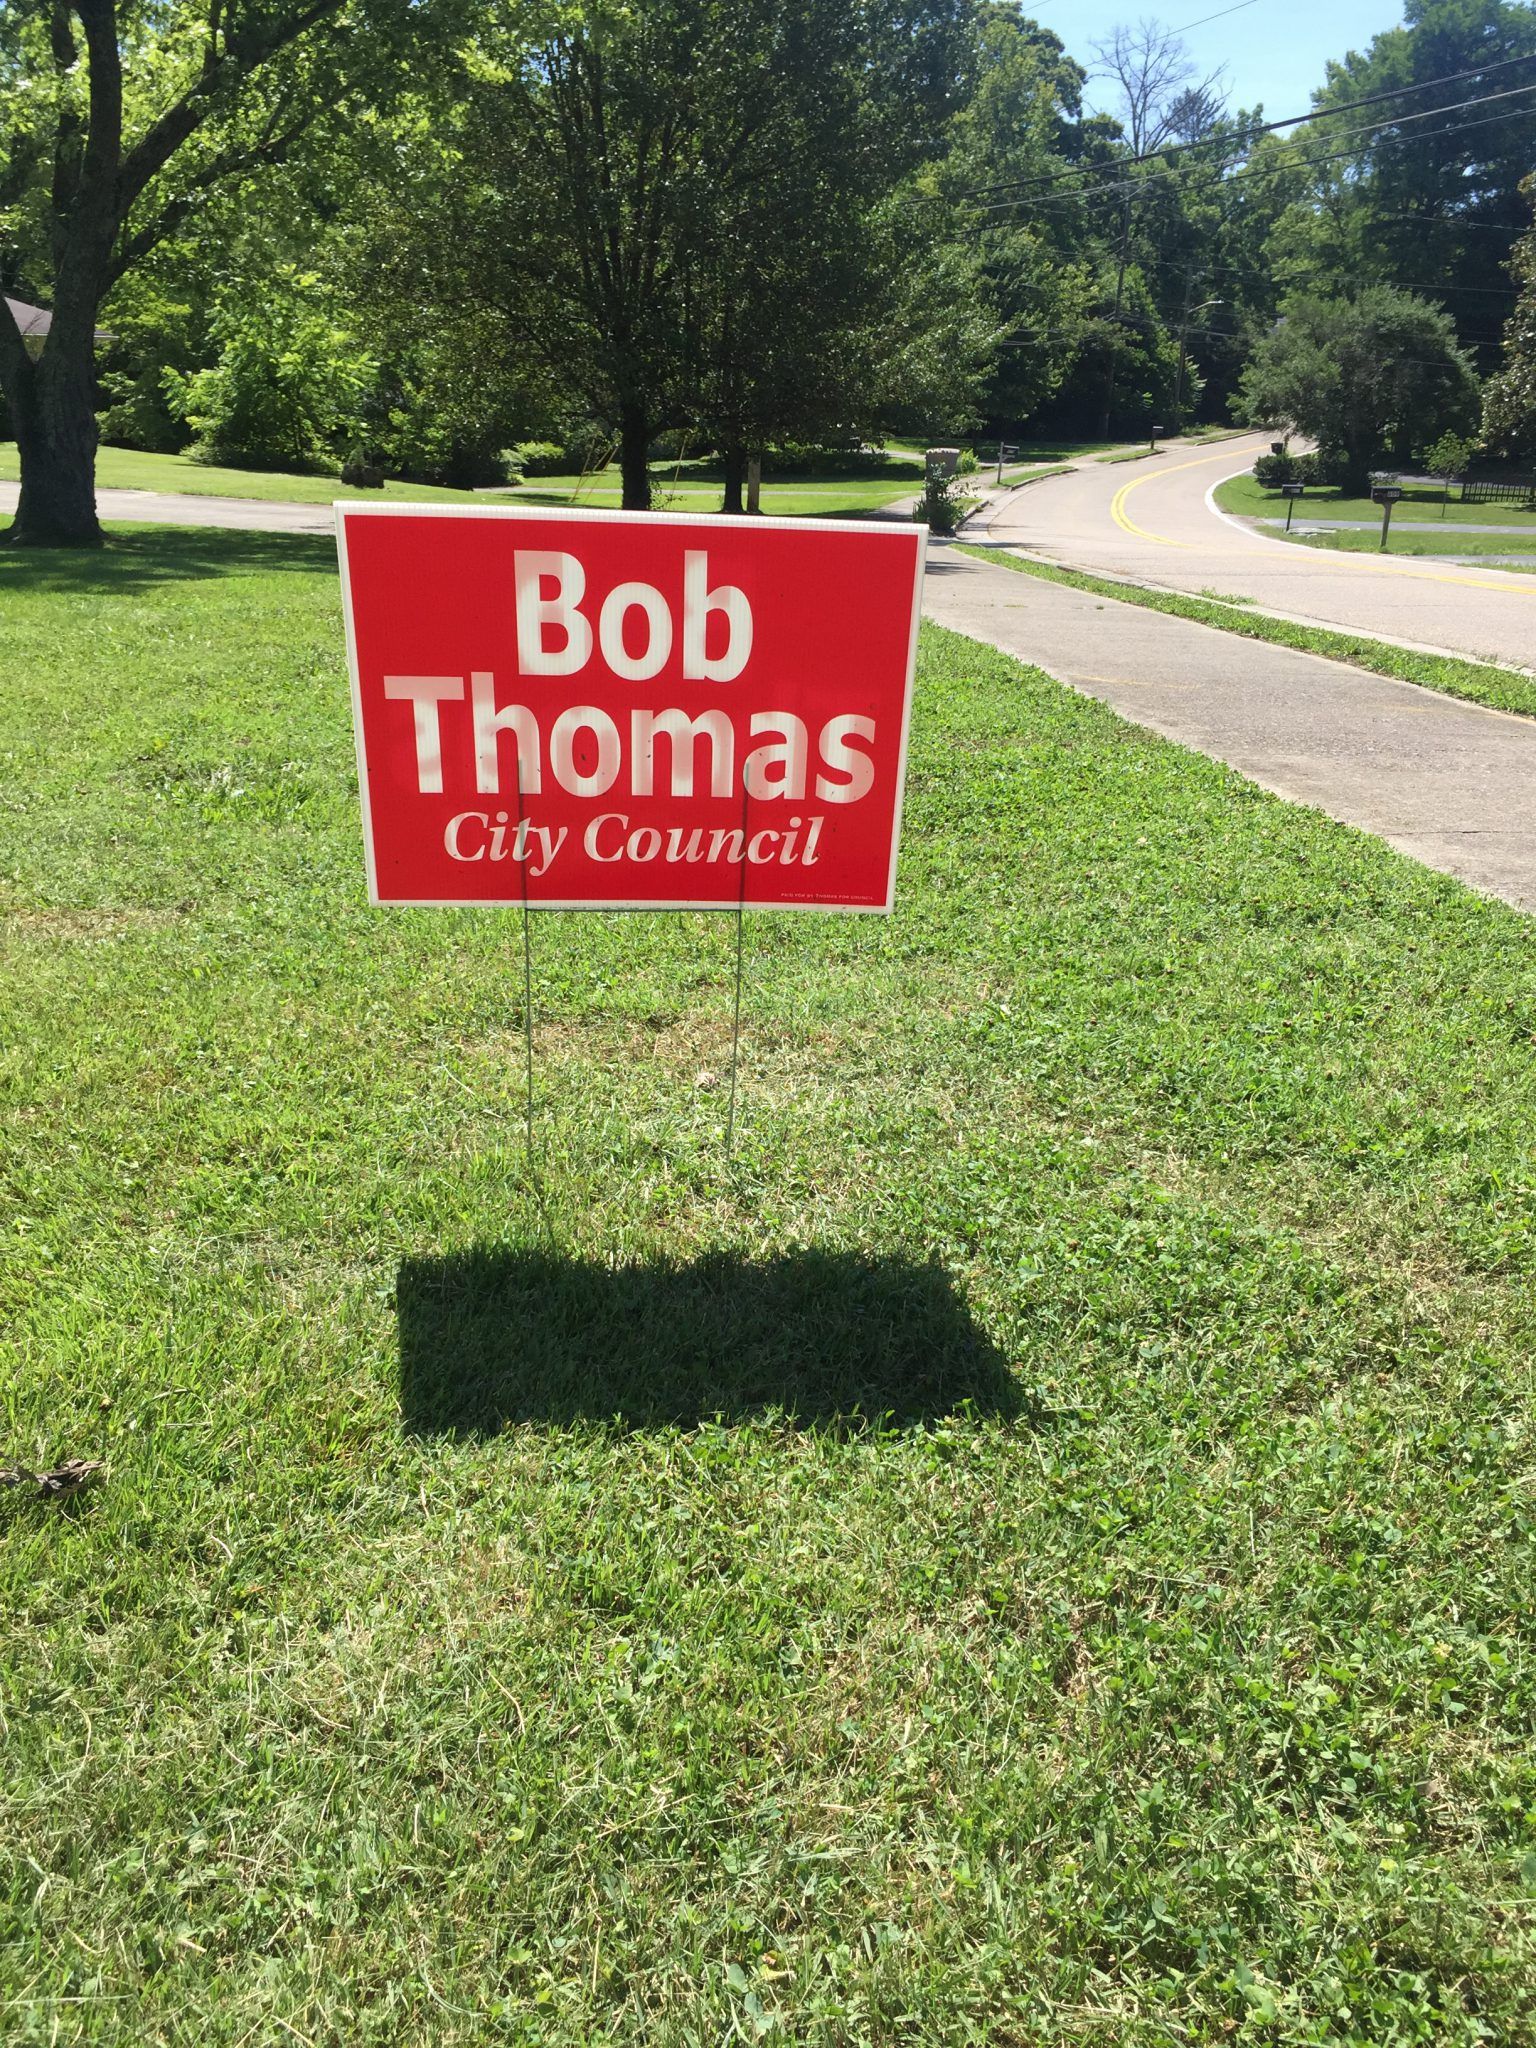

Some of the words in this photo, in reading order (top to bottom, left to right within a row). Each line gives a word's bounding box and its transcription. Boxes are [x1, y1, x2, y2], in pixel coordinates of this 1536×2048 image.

[513, 549, 754, 683] Bob
[383, 671, 877, 804] Thomas
[443, 811, 568, 877] City
[583, 813, 825, 866] Council
